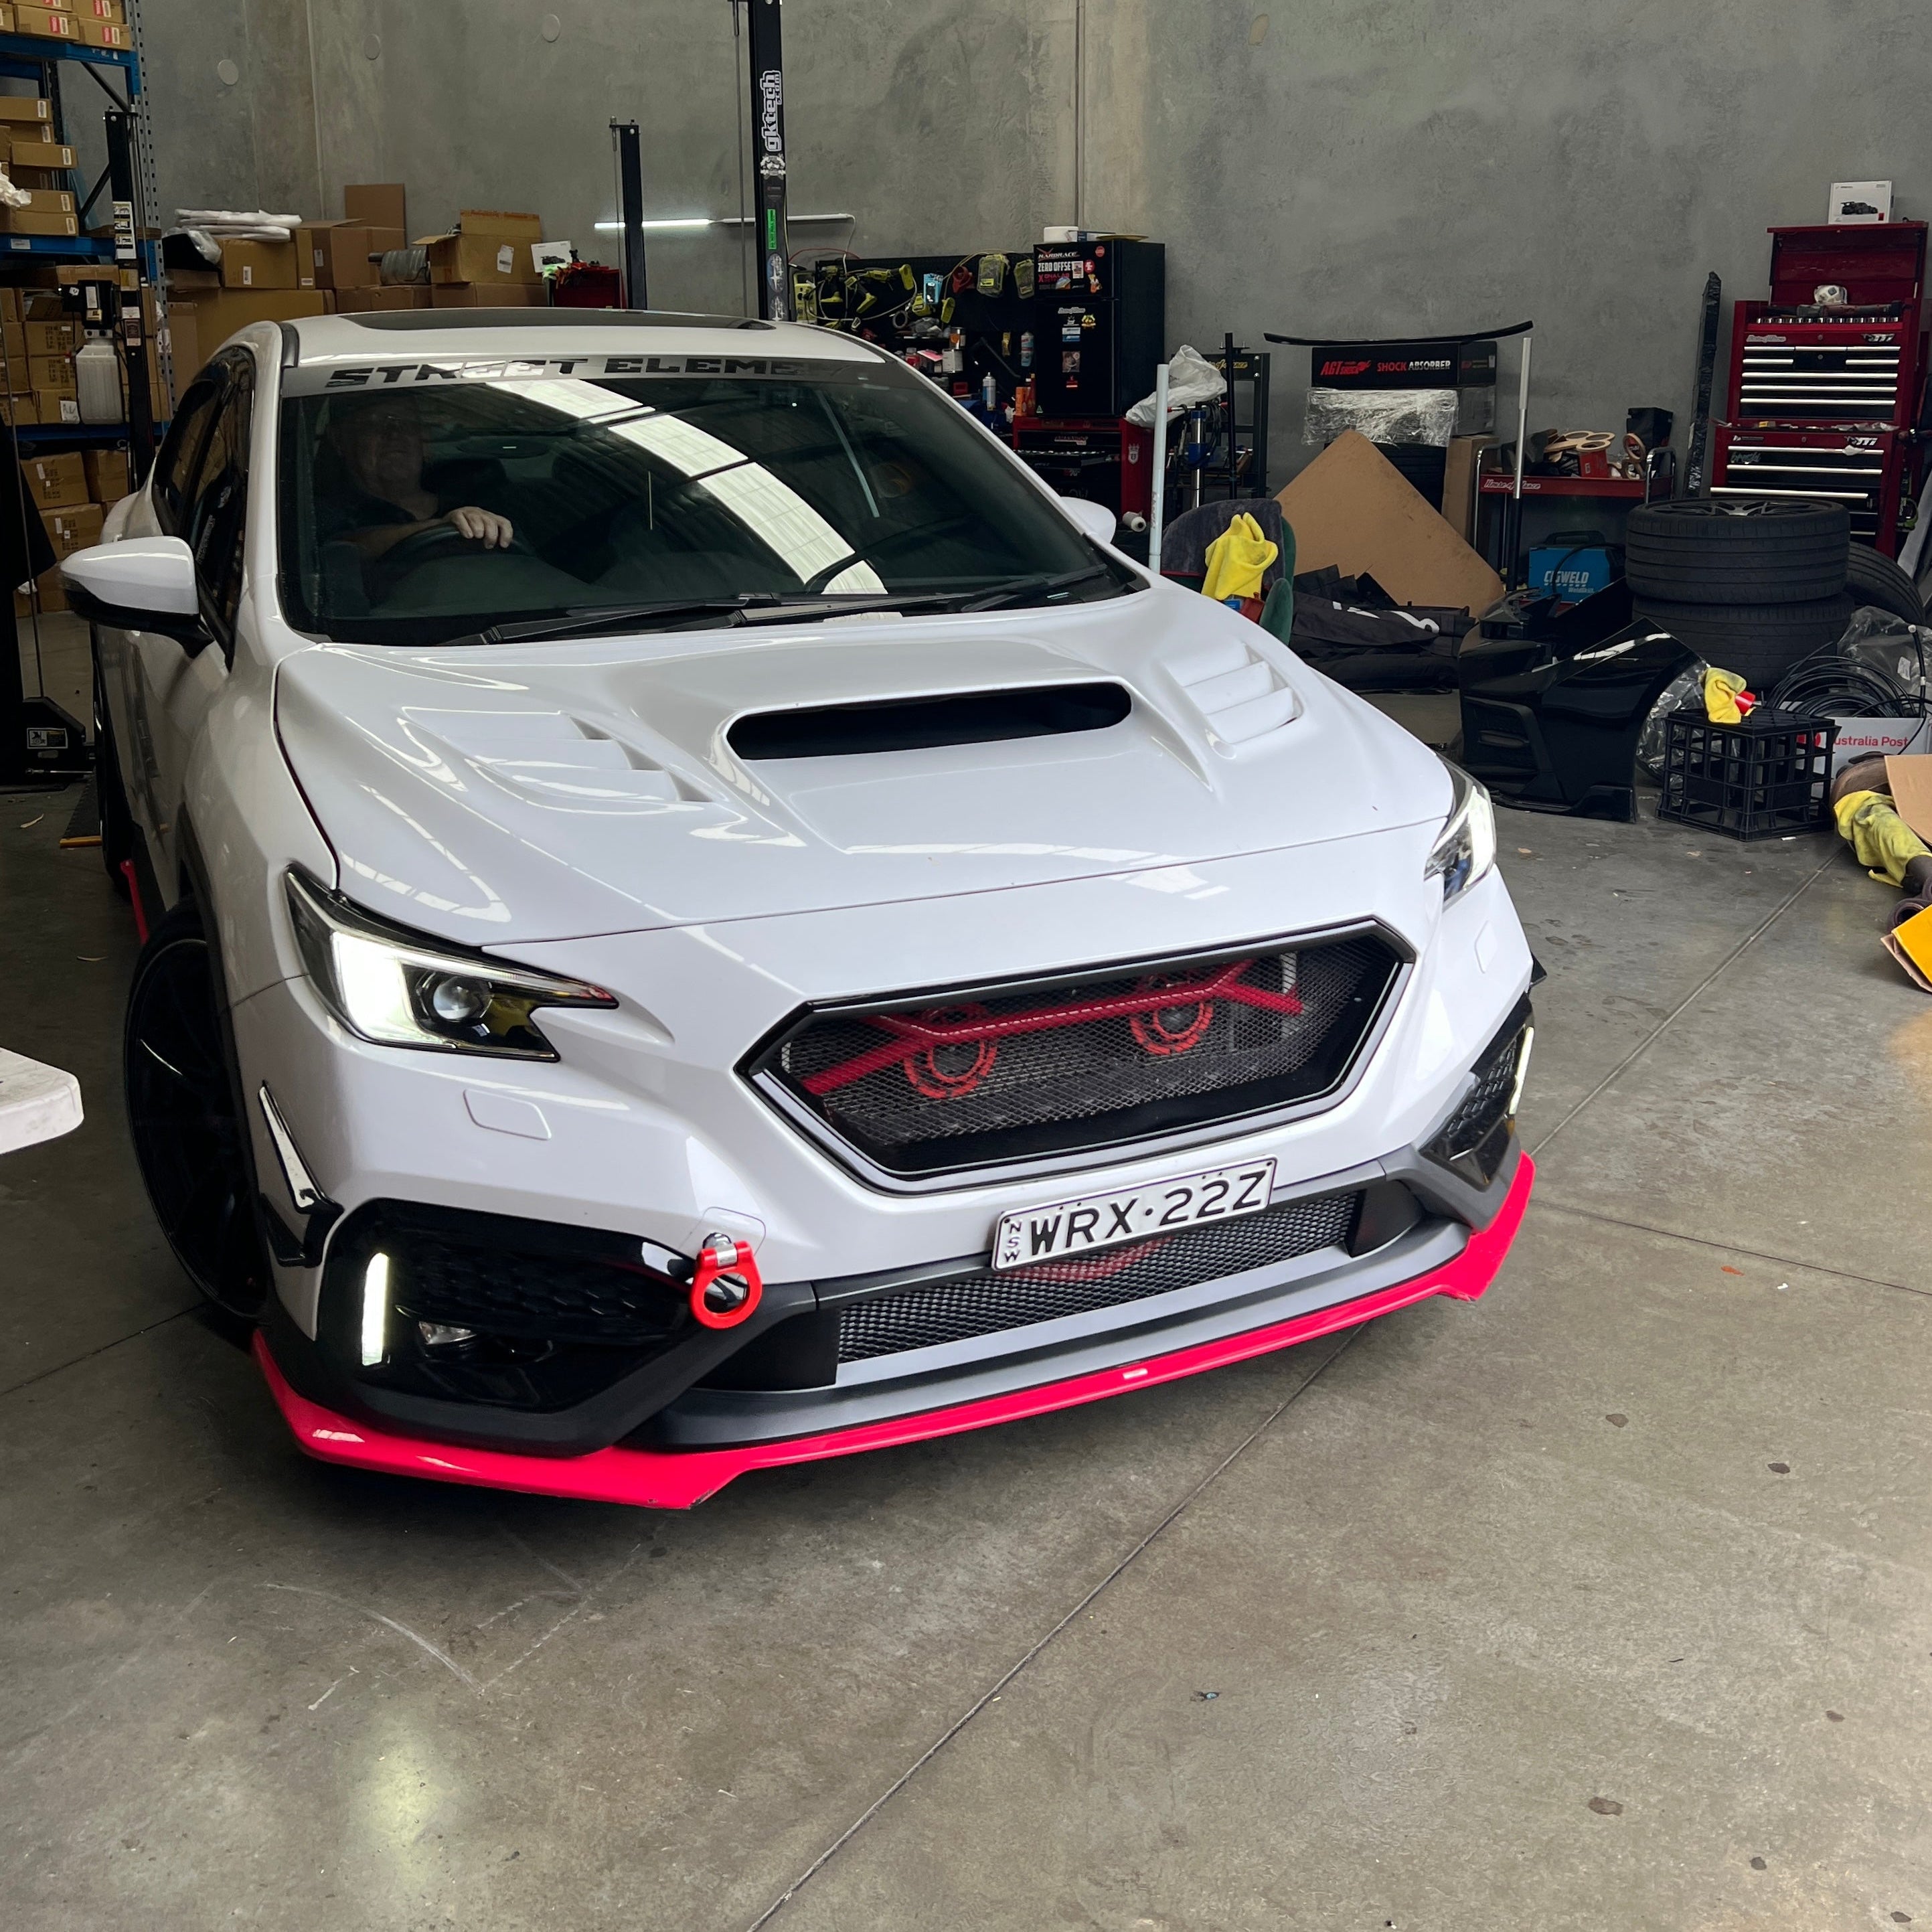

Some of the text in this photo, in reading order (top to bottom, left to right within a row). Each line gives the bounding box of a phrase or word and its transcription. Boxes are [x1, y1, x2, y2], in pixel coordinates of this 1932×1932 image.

[762, 73, 781, 151] gktech
[1038, 260, 1074, 272] ZERO OFFSE
[1320, 361, 1344, 376] AGT
[1376, 361, 1406, 372] SHOCK
[1408, 360, 1451, 371] ABSORBER
[1544, 570, 1590, 584] CIGWELD
[1834, 736, 1909, 747] ustralia Post
[1003, 1220, 1022, 1263] NSW
